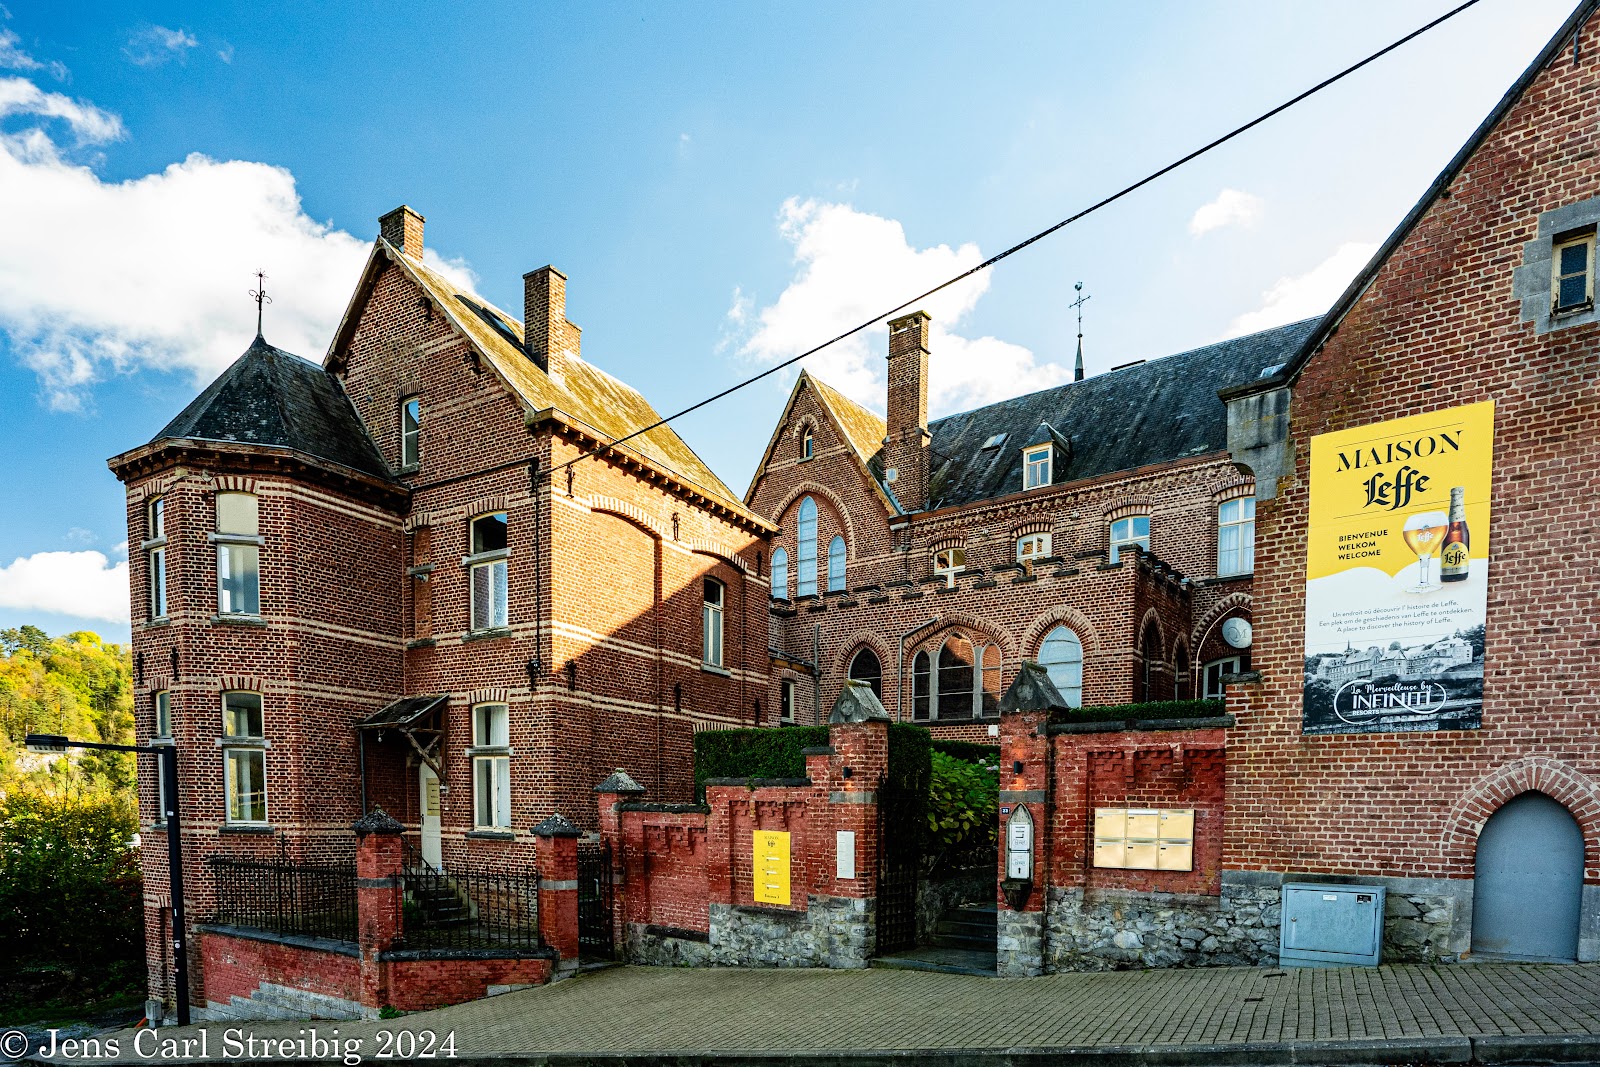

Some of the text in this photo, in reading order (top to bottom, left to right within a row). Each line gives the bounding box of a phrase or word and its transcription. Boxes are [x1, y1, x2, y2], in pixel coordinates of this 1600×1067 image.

[1336, 430, 1464, 473] MAISON
[1362, 465, 1431, 512] Leffe
[1339, 529, 1388, 542] BIENVENUE
[1338, 541, 1376, 551] WELKOM
[1338, 549, 1381, 560] WELCOME
[1444, 550, 1466, 566] Leffe
[1407, 603, 1430, 611] histoire
[1331, 619, 1343, 627] plek
[1413, 610, 1429, 618] Leffe
[1343, 625, 1358, 634] place
[1367, 623, 1391, 631] discover
[1404, 619, 1424, 627] history
[1351, 681, 1433, 695] La Merveilleuse by
[1352, 690, 1431, 710] INFINITI
